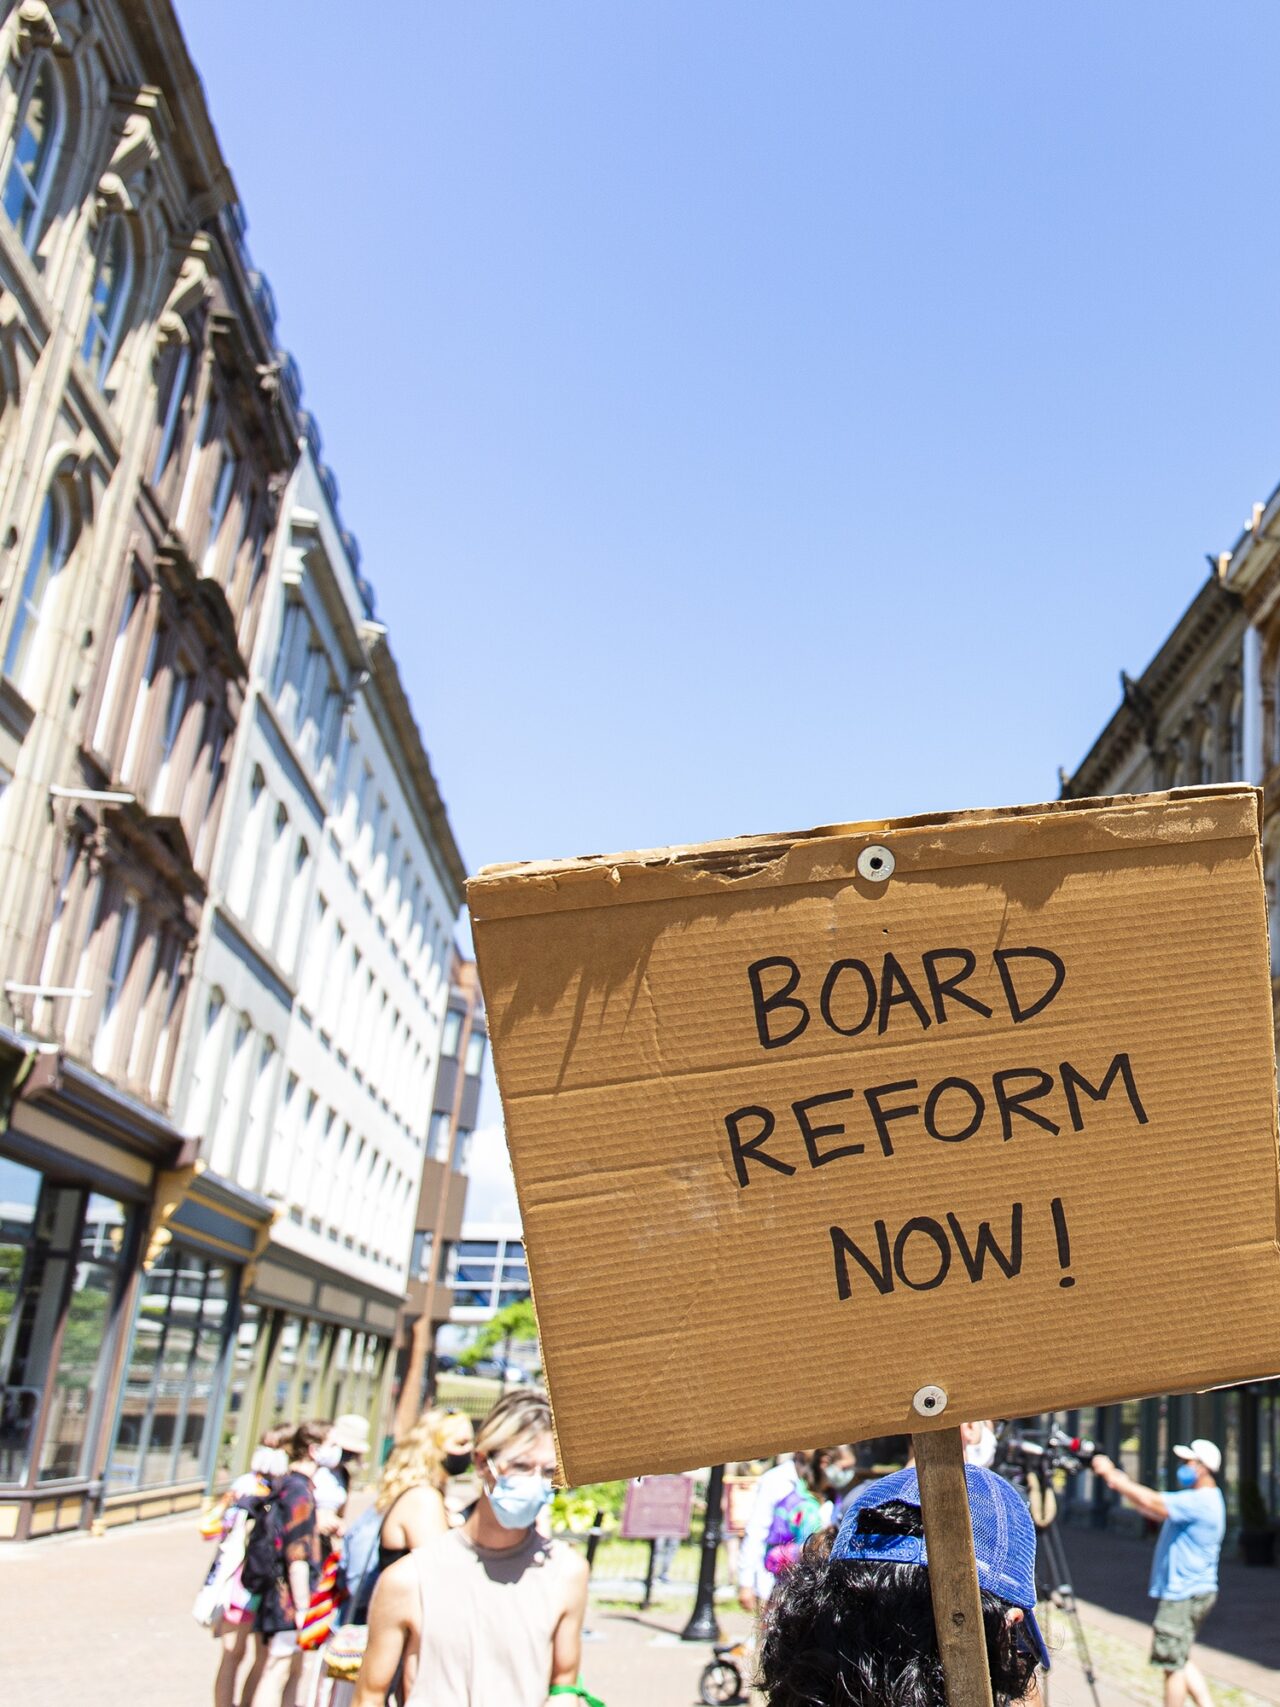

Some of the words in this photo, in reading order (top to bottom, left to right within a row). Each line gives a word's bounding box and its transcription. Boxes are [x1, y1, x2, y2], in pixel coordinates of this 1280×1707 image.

[747, 946, 1067, 1050] BOARD
[724, 1052, 1150, 1189] REFORM
[829, 1197, 1077, 1301] NOW!
